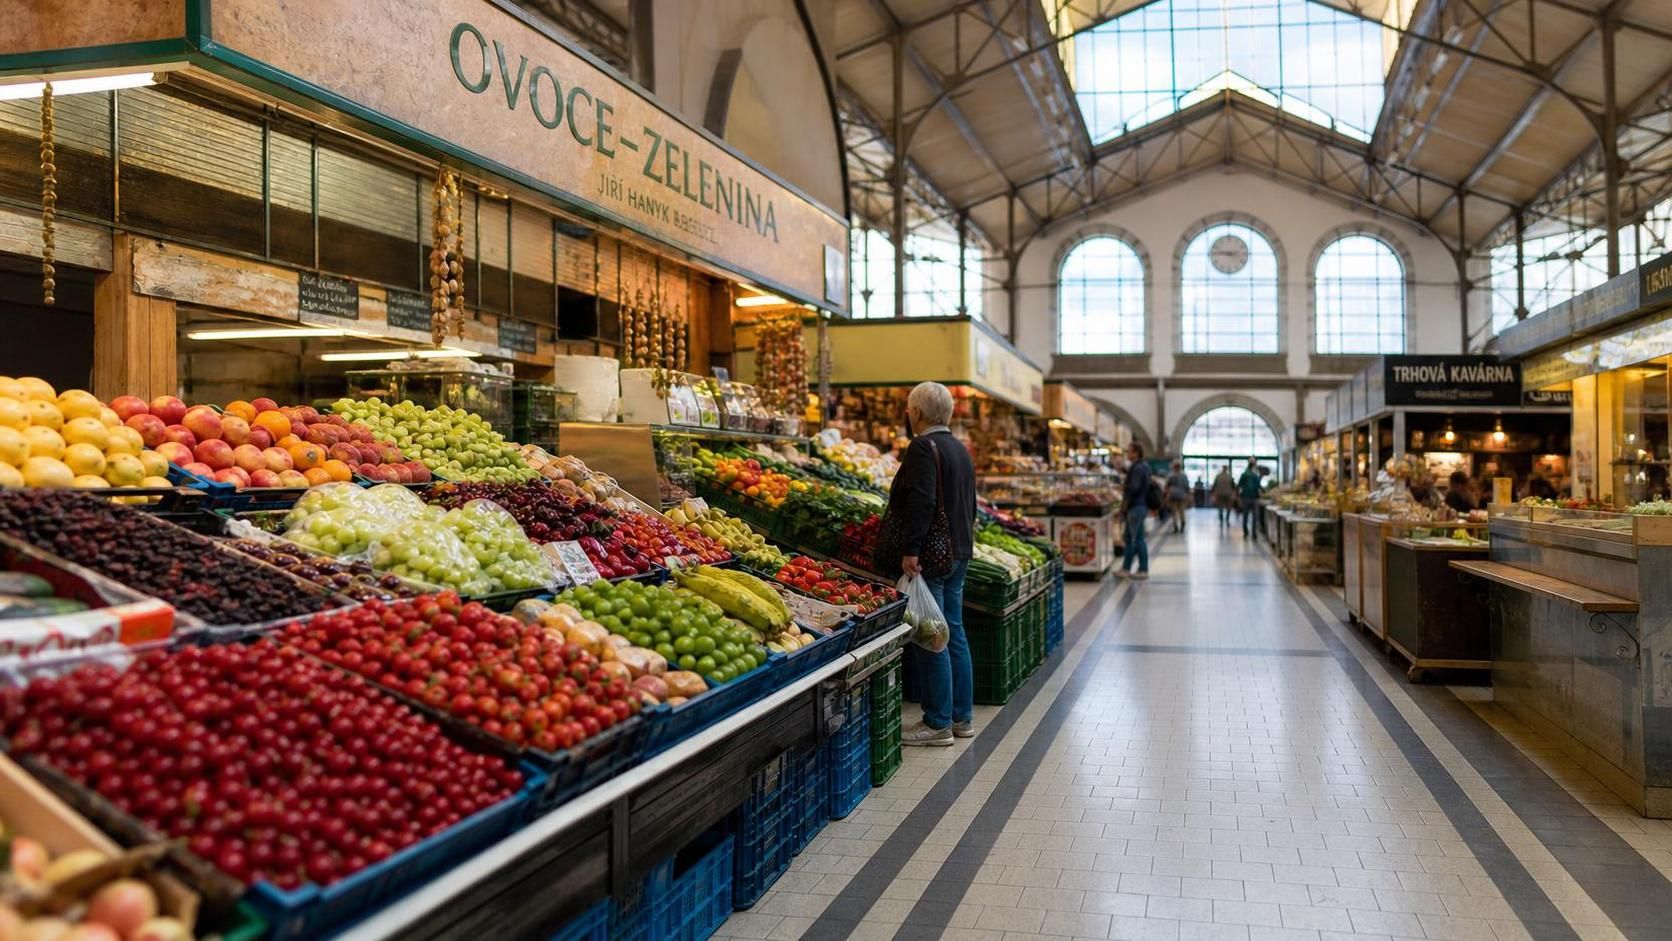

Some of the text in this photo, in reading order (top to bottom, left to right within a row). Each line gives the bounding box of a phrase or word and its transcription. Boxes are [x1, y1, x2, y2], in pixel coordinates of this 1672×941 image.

[597, 173, 670, 224] JIŘÍ HANYK
[1392, 361, 1514, 383] TRHOVÁ KAVÁRNA
